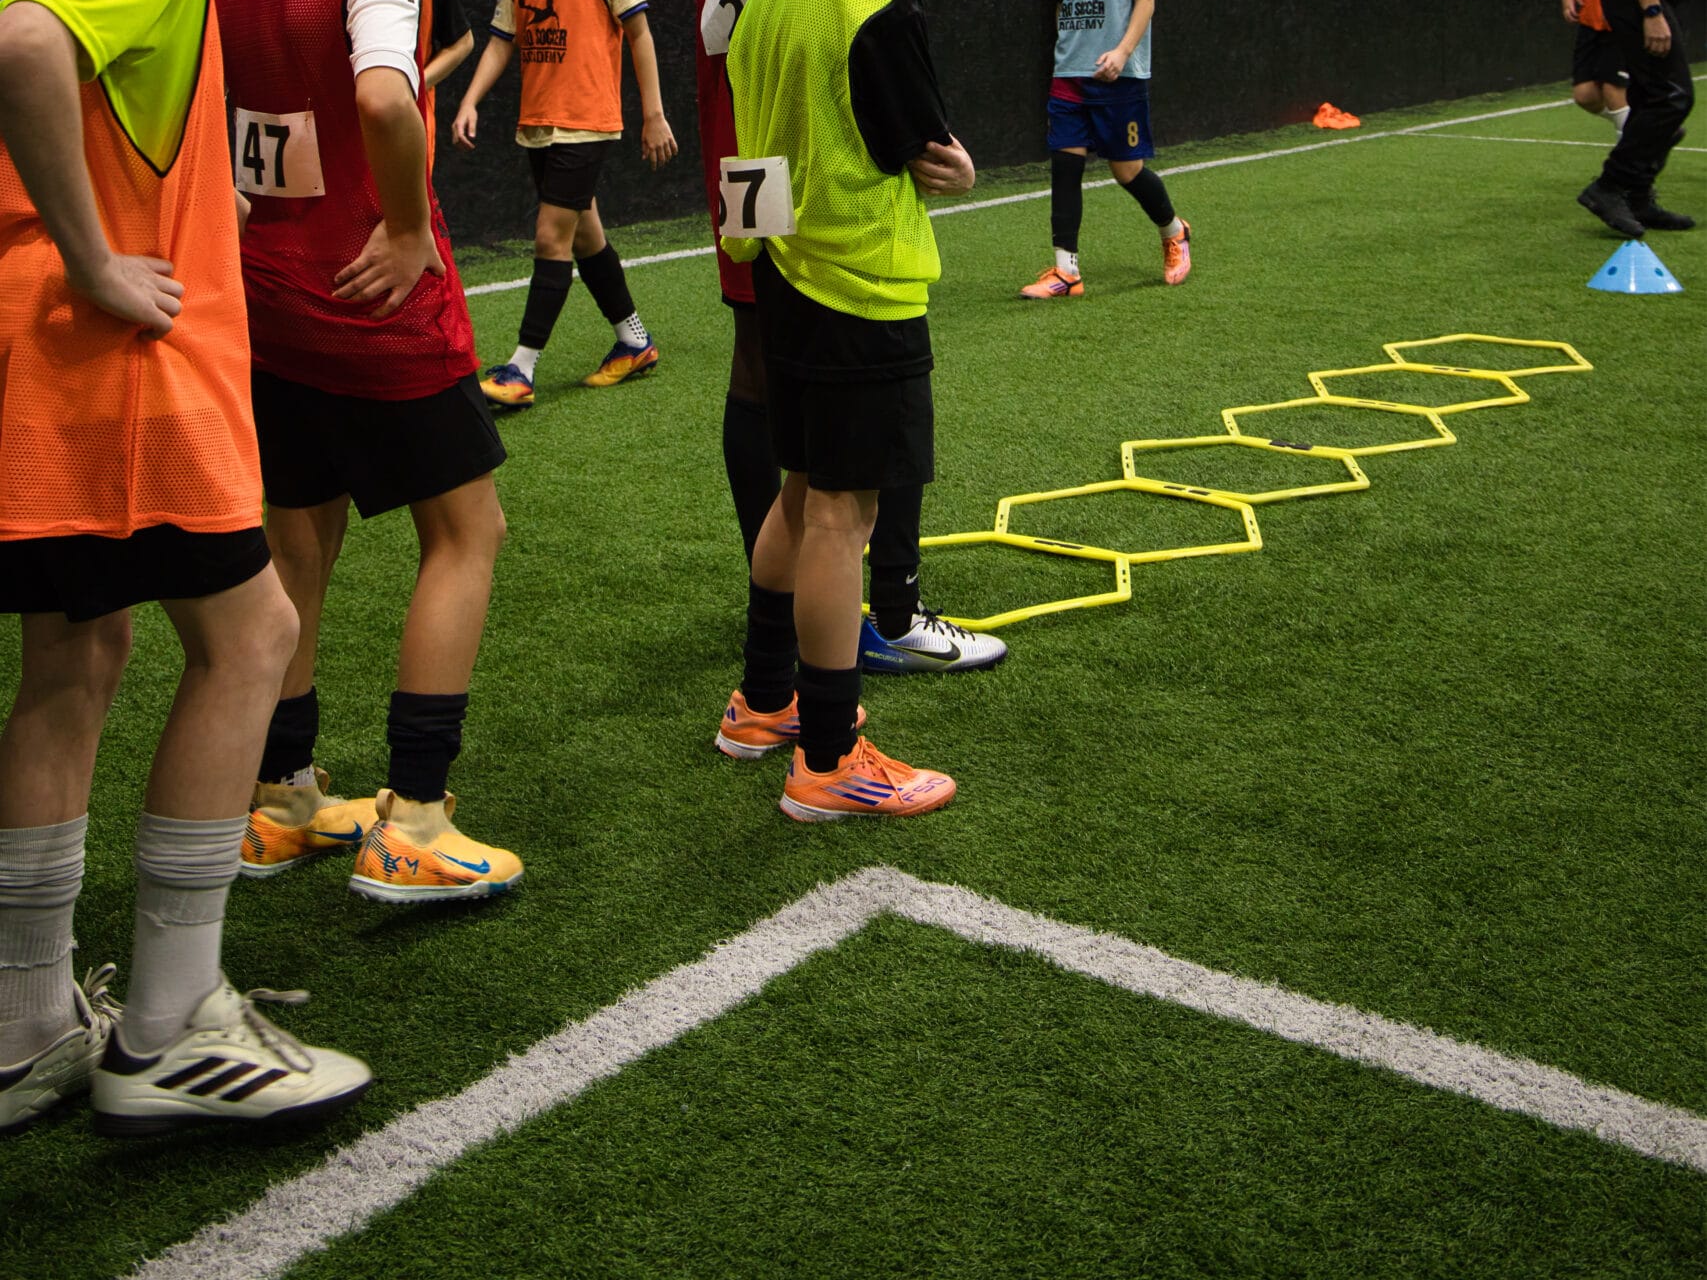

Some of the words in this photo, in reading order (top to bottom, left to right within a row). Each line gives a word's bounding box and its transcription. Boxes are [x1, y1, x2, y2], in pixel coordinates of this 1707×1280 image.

[1075, 1, 1105, 15] SOCCER
[1059, 19, 1105, 31] ACADEMY
[536, 28, 567, 46] SOCCER
[1127, 121, 1139, 148] 8
[243, 122, 291, 188] 47
[902, 777, 947, 802] F50
